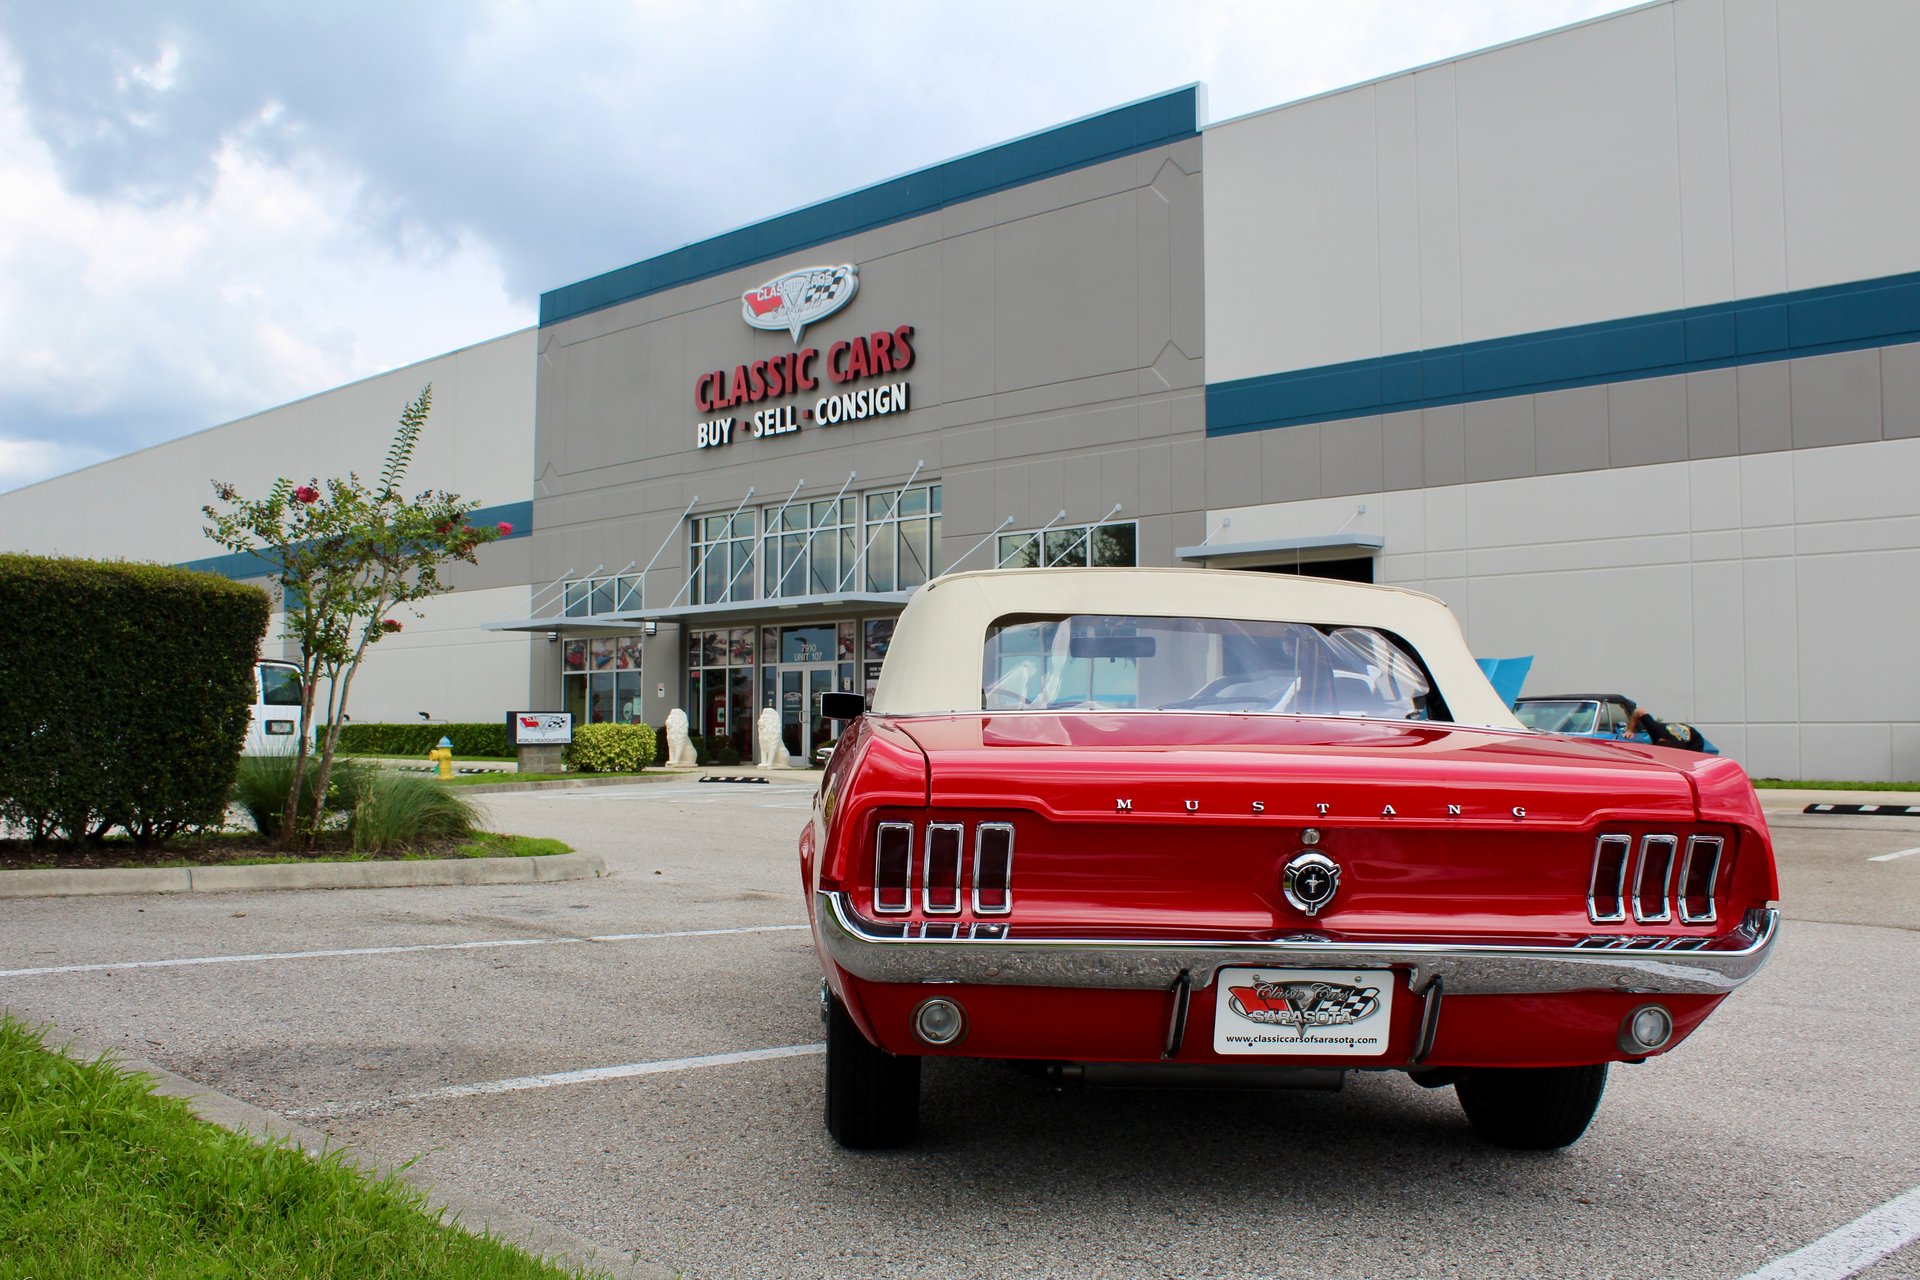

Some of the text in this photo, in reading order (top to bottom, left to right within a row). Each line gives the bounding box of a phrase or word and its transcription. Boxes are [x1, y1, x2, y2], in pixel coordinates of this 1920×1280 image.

[757, 271, 832, 301] CLASSIC CARS
[695, 325, 914, 413] CLASSIC CARS
[697, 382, 909, 448] BUY SELL CONSIGN
[794, 652, 822, 661] UNIT 107
[801, 644, 816, 652] 7910
[1116, 799, 1526, 817] MUSTANG
[1253, 981, 1353, 1001] Classic Cars
[1252, 1010, 1353, 1024] SARASOTA
[1226, 1034, 1377, 1044] www.classiccarsofsarasota.com
